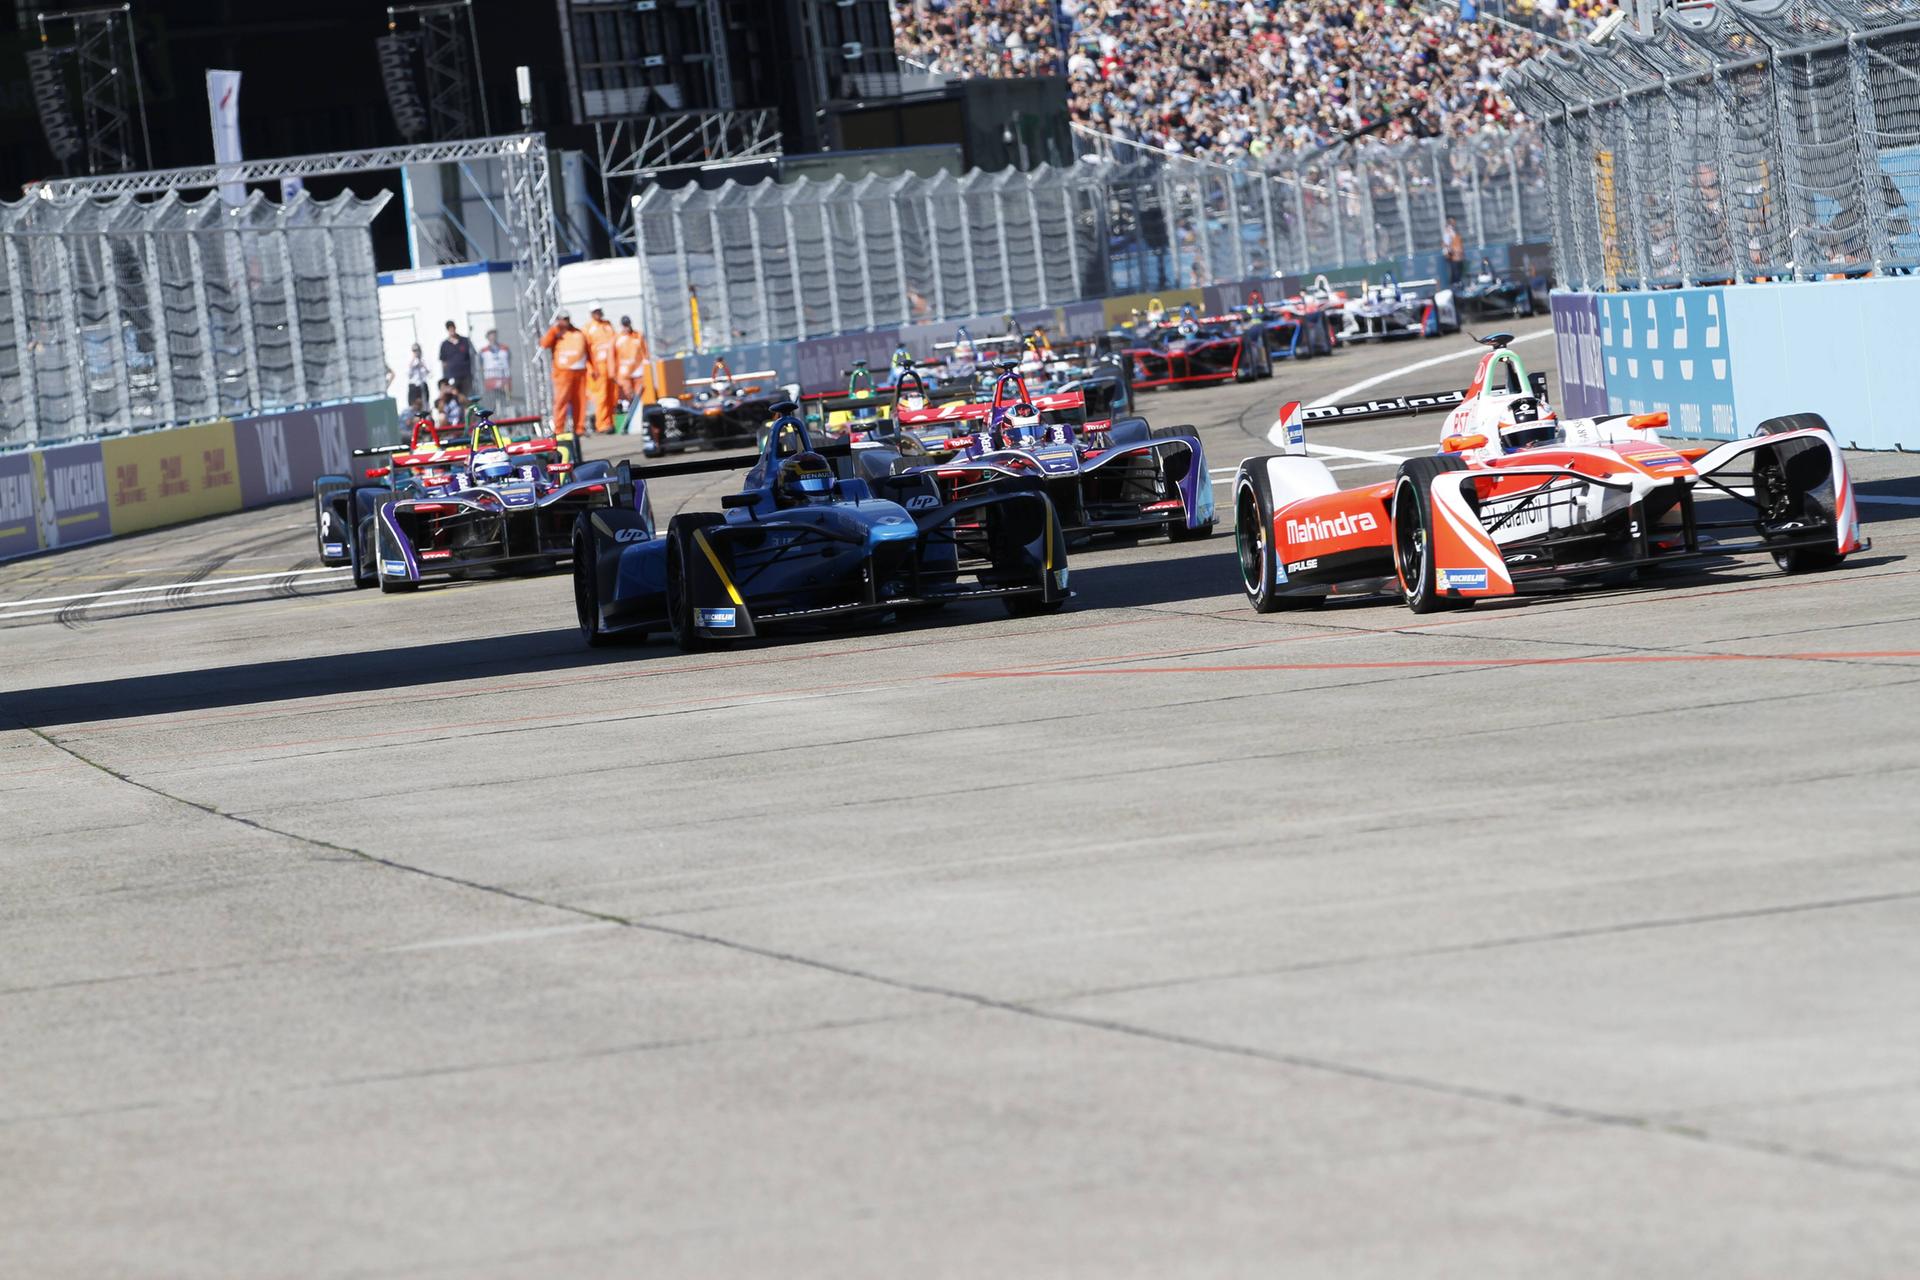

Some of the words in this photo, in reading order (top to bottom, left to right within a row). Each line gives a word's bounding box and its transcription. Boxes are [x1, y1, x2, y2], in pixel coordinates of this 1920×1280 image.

[255, 420, 292, 495] VISA
[314, 411, 352, 476] VISA
[951, 439, 973, 447] TOTAL
[53, 461, 106, 512] MICHELIN
[1286, 511, 1377, 545] Mahindra
[1450, 574, 1486, 583] MICHELIN
